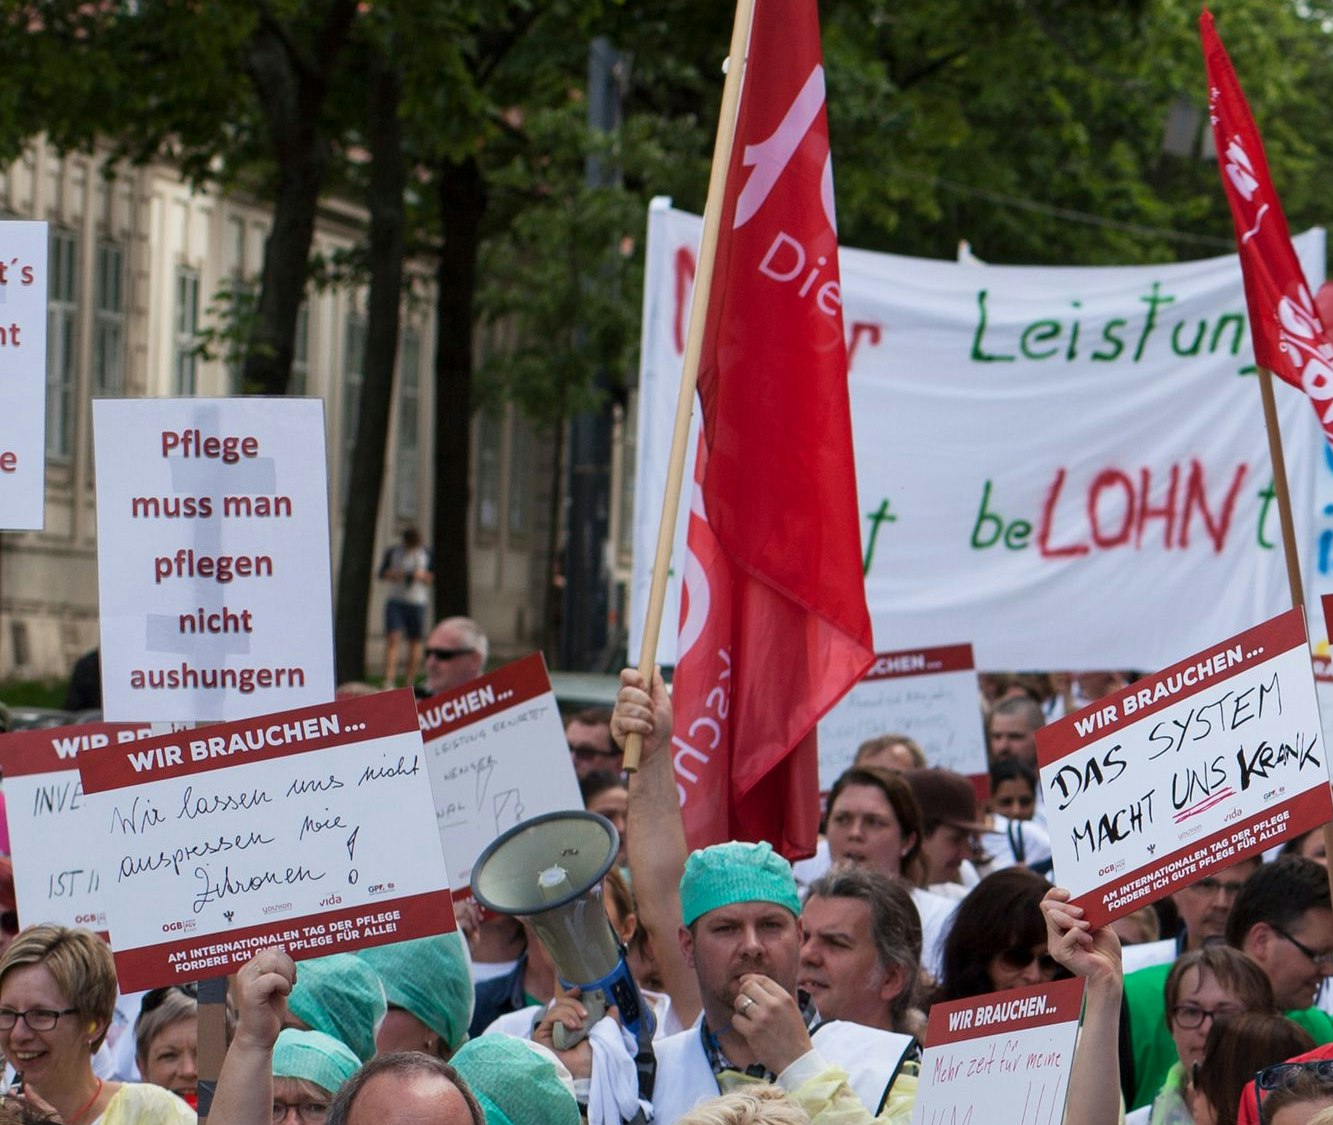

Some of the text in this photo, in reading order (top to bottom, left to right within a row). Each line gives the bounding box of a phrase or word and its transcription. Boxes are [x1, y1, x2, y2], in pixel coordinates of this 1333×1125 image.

[970, 283, 1256, 377] Leistun
[161, 430, 259, 465] Pflege
[132, 496, 292, 518] muss man
[154, 549, 273, 583] pflegen
[179, 607, 252, 634] nicht
[130, 663, 305, 693] aushungern
[1050, 672, 1282, 810] DAS SYSTEM
[1074, 705, 1118, 738] WIR
[127, 743, 184, 772] WIR
[110, 754, 420, 834] Wir lassen uns nicht
[1072, 732, 1321, 862] MACHT UNS KRANK
[118, 832, 275, 882] auspressen
[193, 863, 326, 913] Zitronen
[319, 894, 342, 907] vida
[168, 911, 401, 963] AM INTERNATIONALEN TAG DER PFLEGE
[175, 923, 397, 973] FORDERE ICH PFLEGE FÜR ALLE!
[949, 1009, 972, 1032] WIR
[933, 1054, 963, 1086] Mehr
[1026, 1038, 1061, 1069] meine
